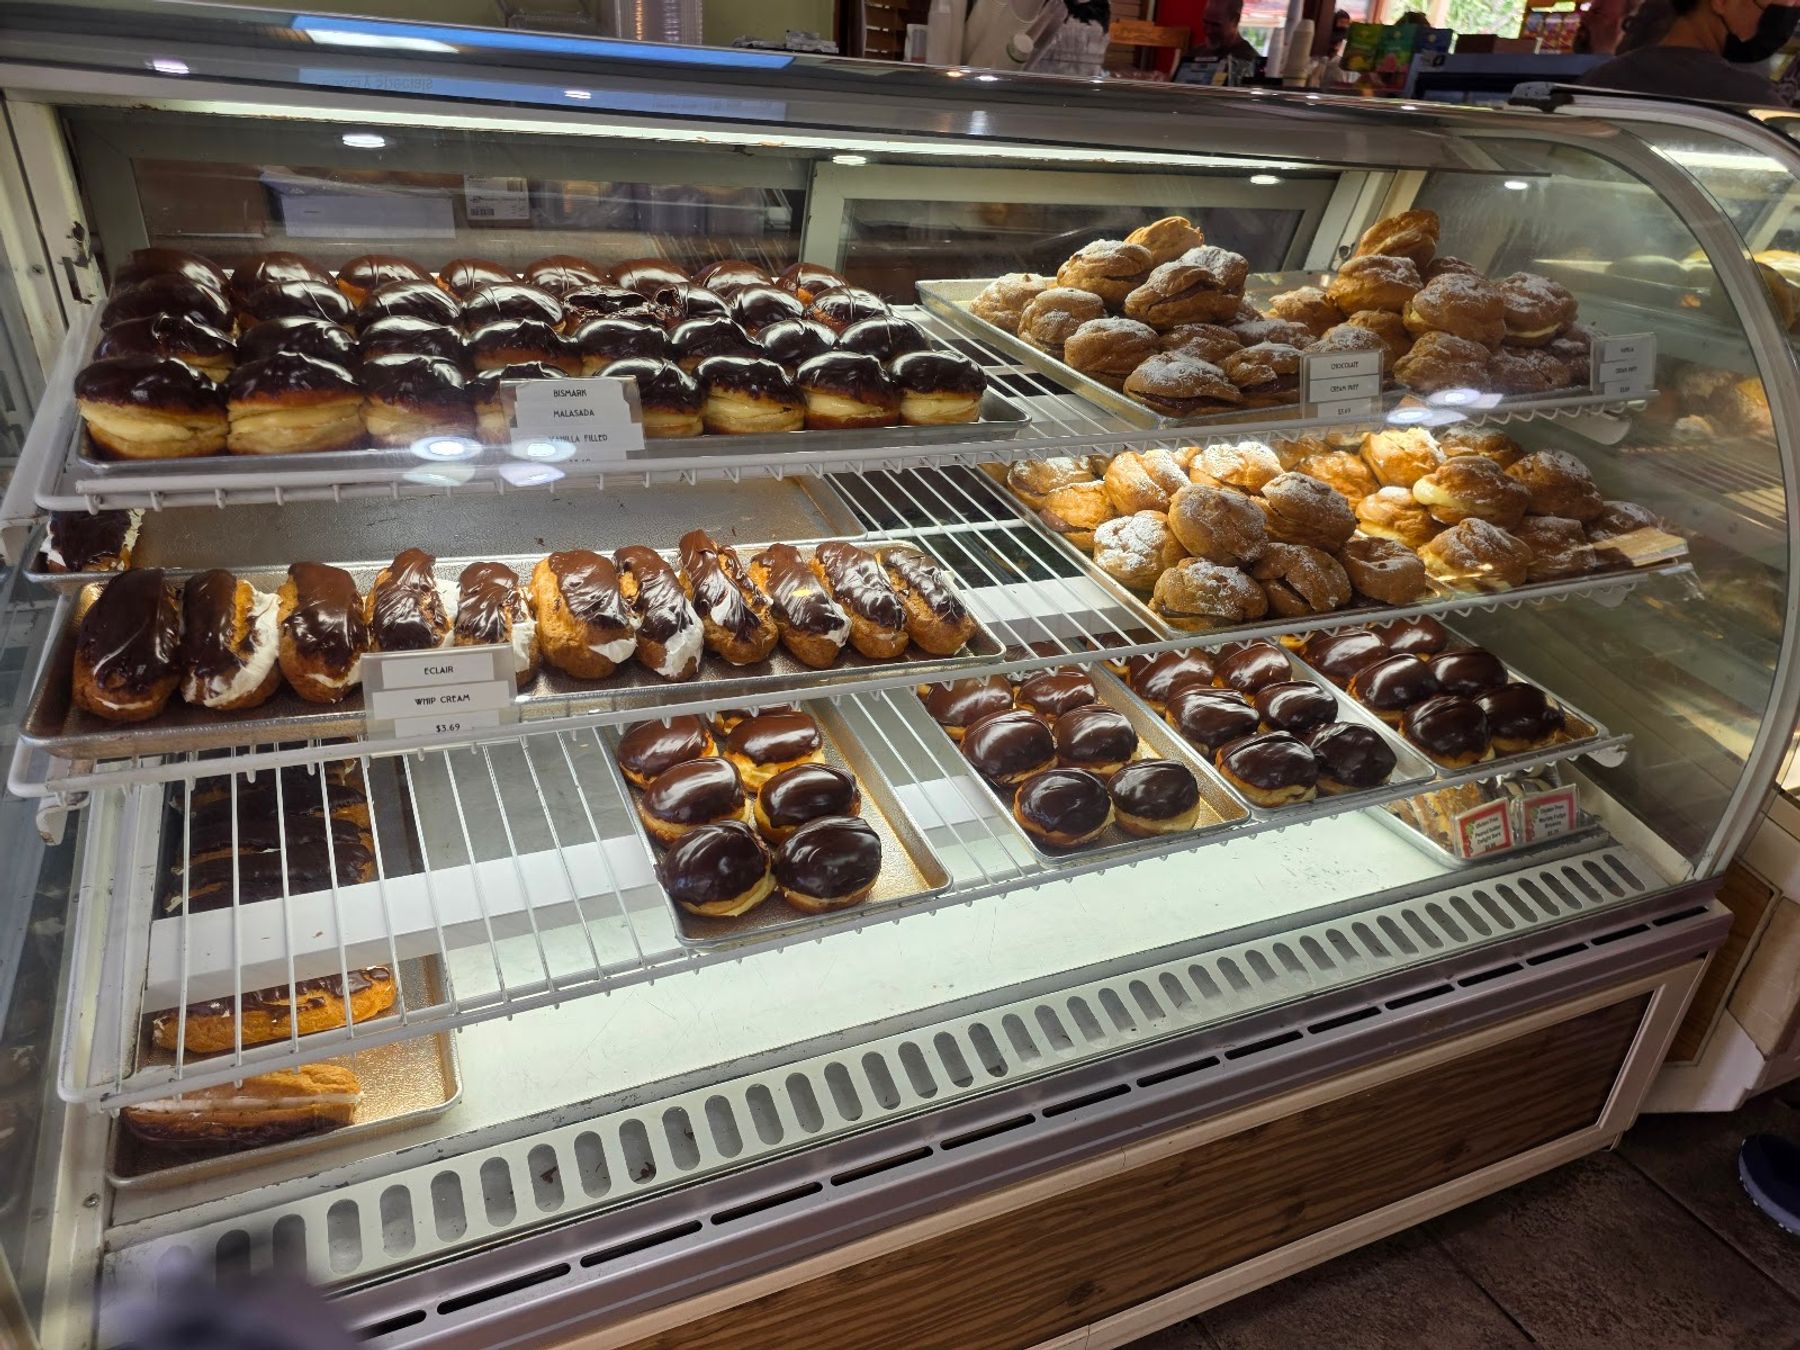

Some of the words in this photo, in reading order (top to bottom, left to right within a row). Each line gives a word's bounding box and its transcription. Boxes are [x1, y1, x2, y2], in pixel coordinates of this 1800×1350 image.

[1331, 362, 1359, 370] CHOCOLATE
[553, 389, 587, 398] BISMARK
[553, 409, 596, 418] MALASADA
[584, 434, 608, 442] FILLED
[424, 666, 454, 675] ECLAIR
[414, 697, 436, 706] WHIP
[440, 694, 471, 704] CREAM
[436, 723, 461, 733] $3.69
